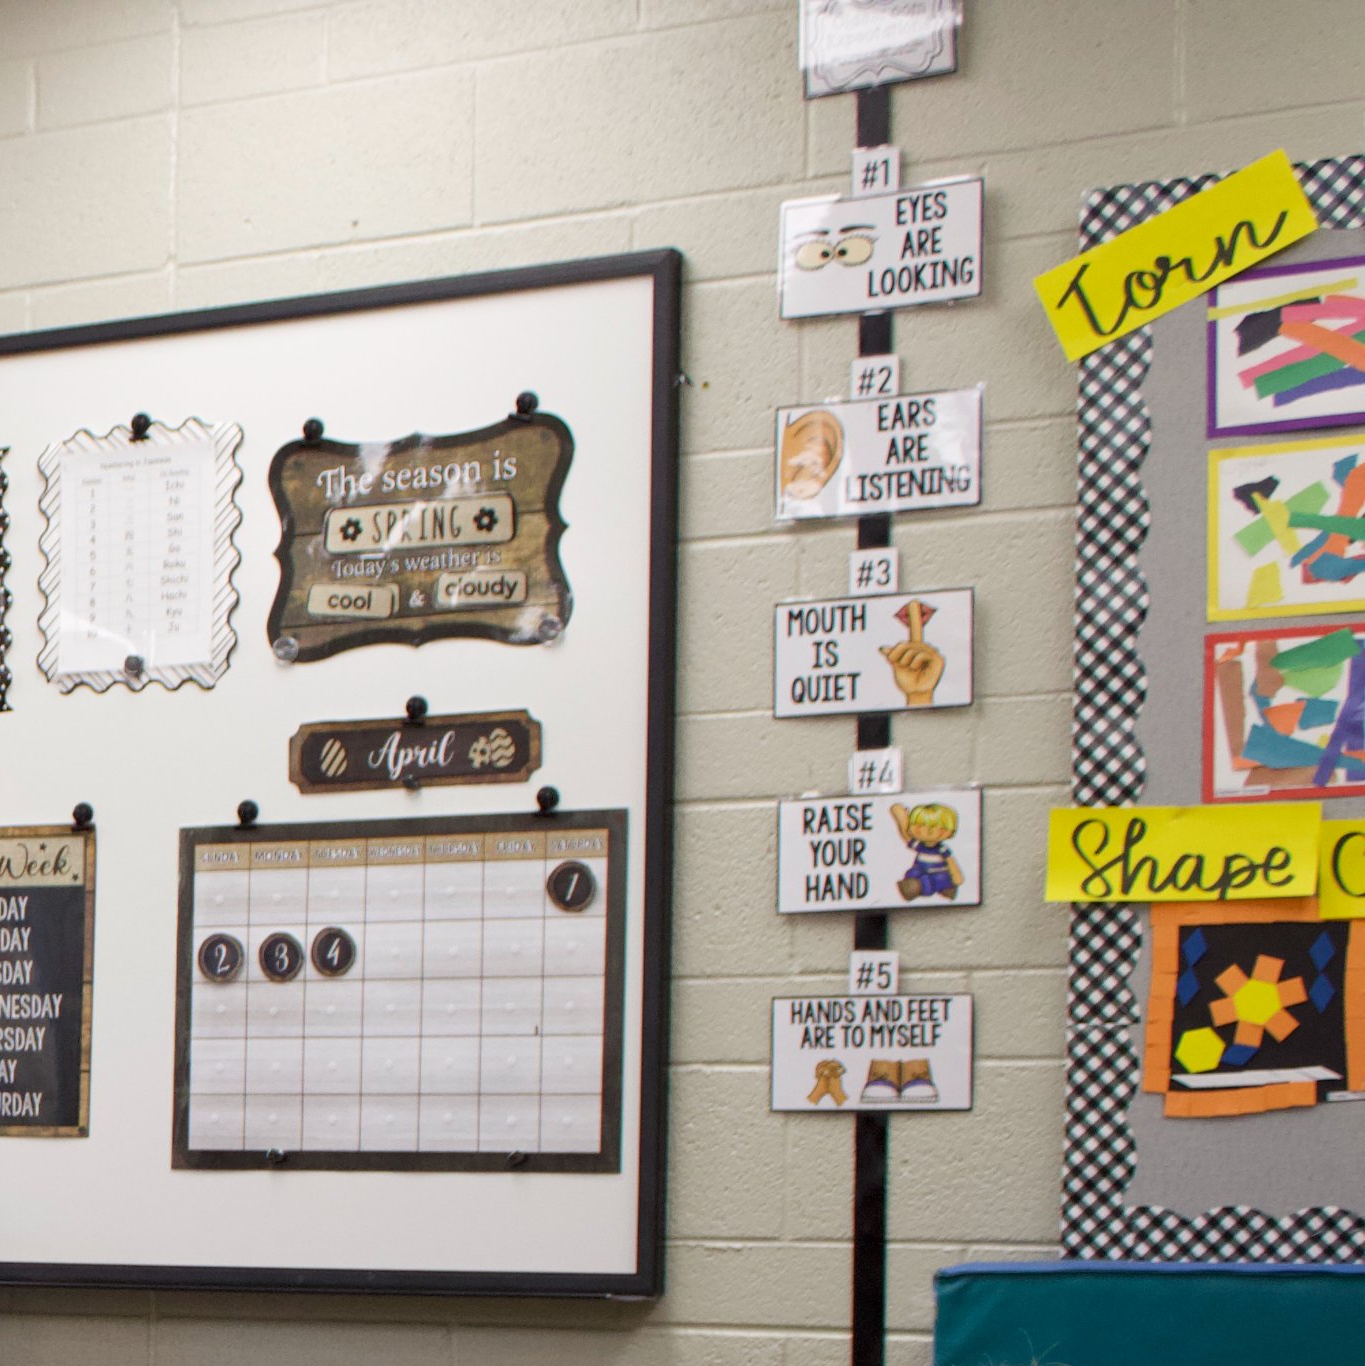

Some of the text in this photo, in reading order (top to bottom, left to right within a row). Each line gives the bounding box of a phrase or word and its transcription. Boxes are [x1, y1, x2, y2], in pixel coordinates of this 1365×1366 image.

[862, 159, 891, 188] #1
[896, 193, 947, 225] EYES
[901, 226, 942, 258] ARE
[868, 256, 974, 297] LOOKING
[1056, 209, 1288, 337] Torn
[859, 367, 893, 395] #2
[878, 400, 937, 433] EARS
[886, 433, 929, 464] ARE
[317, 450, 518, 500] The season is
[847, 463, 971, 501] LISTENING
[372, 504, 462, 546] SPRING
[331, 544, 501, 580] Today's weather is
[856, 558, 891, 587] #3
[328, 574, 518, 611] cool & cloudy
[788, 601, 867, 637] MOUTH
[813, 641, 839, 668] IS
[791, 672, 861, 704] QUIET
[367, 729, 456, 781] April
[859, 761, 893, 788] #4
[803, 803, 873, 835] RAISE
[810, 839, 866, 867] YOUR
[1072, 819, 1294, 900] Shape
[566, 872, 580, 901] 1
[805, 872, 869, 903] HAND
[213, 937, 345, 974] 2 3 4
[856, 961, 892, 990] #5
[790, 998, 951, 1025] HANDS AND FEET
[800, 1023, 942, 1050] ARE TO MYSELF
